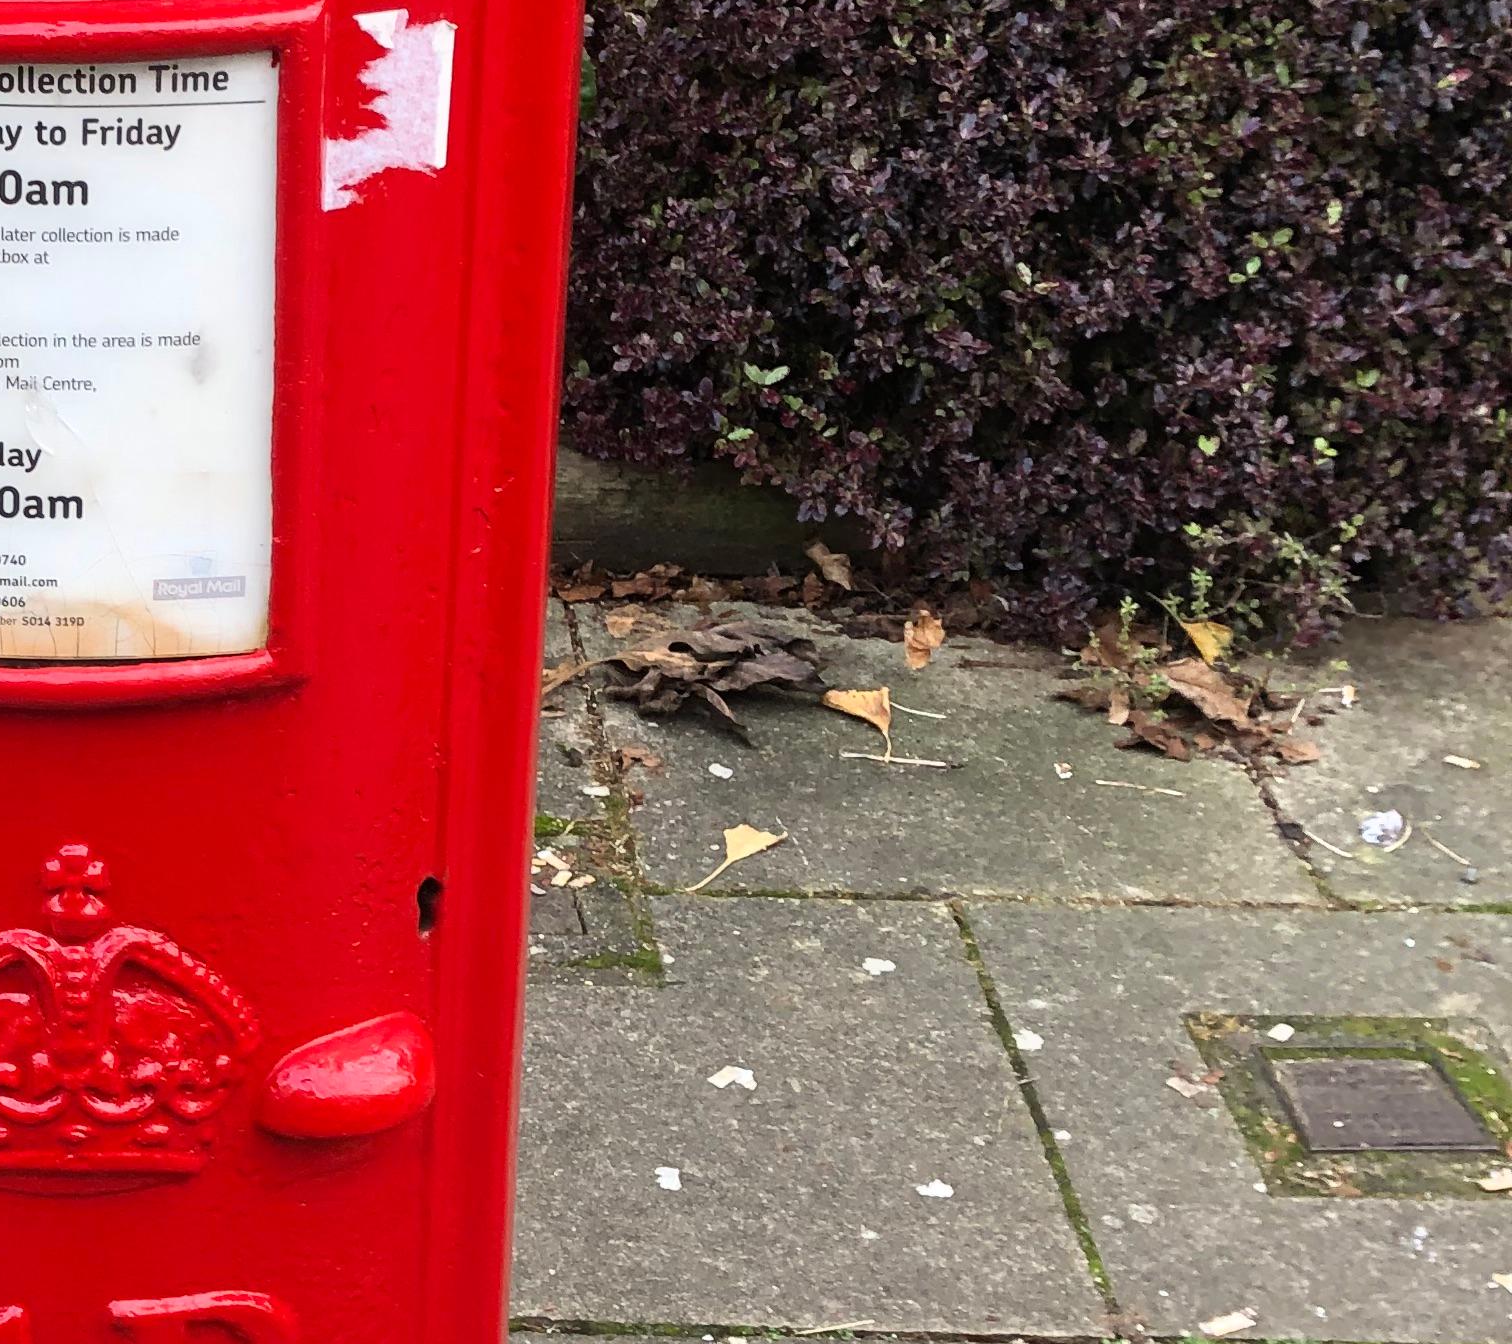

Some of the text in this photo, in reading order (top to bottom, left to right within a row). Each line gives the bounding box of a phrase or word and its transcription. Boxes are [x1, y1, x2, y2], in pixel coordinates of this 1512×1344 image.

[147, 63, 229, 93] Time
[35, 121, 66, 146] to
[82, 118, 181, 151] Friday
[1, 227, 36, 241] later
[41, 228, 112, 242] collection
[119, 228, 130, 242] is
[136, 227, 179, 241] made
[34, 251, 49, 264] at
[54, 334, 66, 347] in
[72, 334, 96, 348] the
[102, 337, 135, 348] area
[141, 333, 152, 347] is
[158, 332, 200, 346] made
[6, 376, 37, 390] Mail
[43, 376, 96, 392] Centre,
[157, 578, 241, 598] Royal Mail
